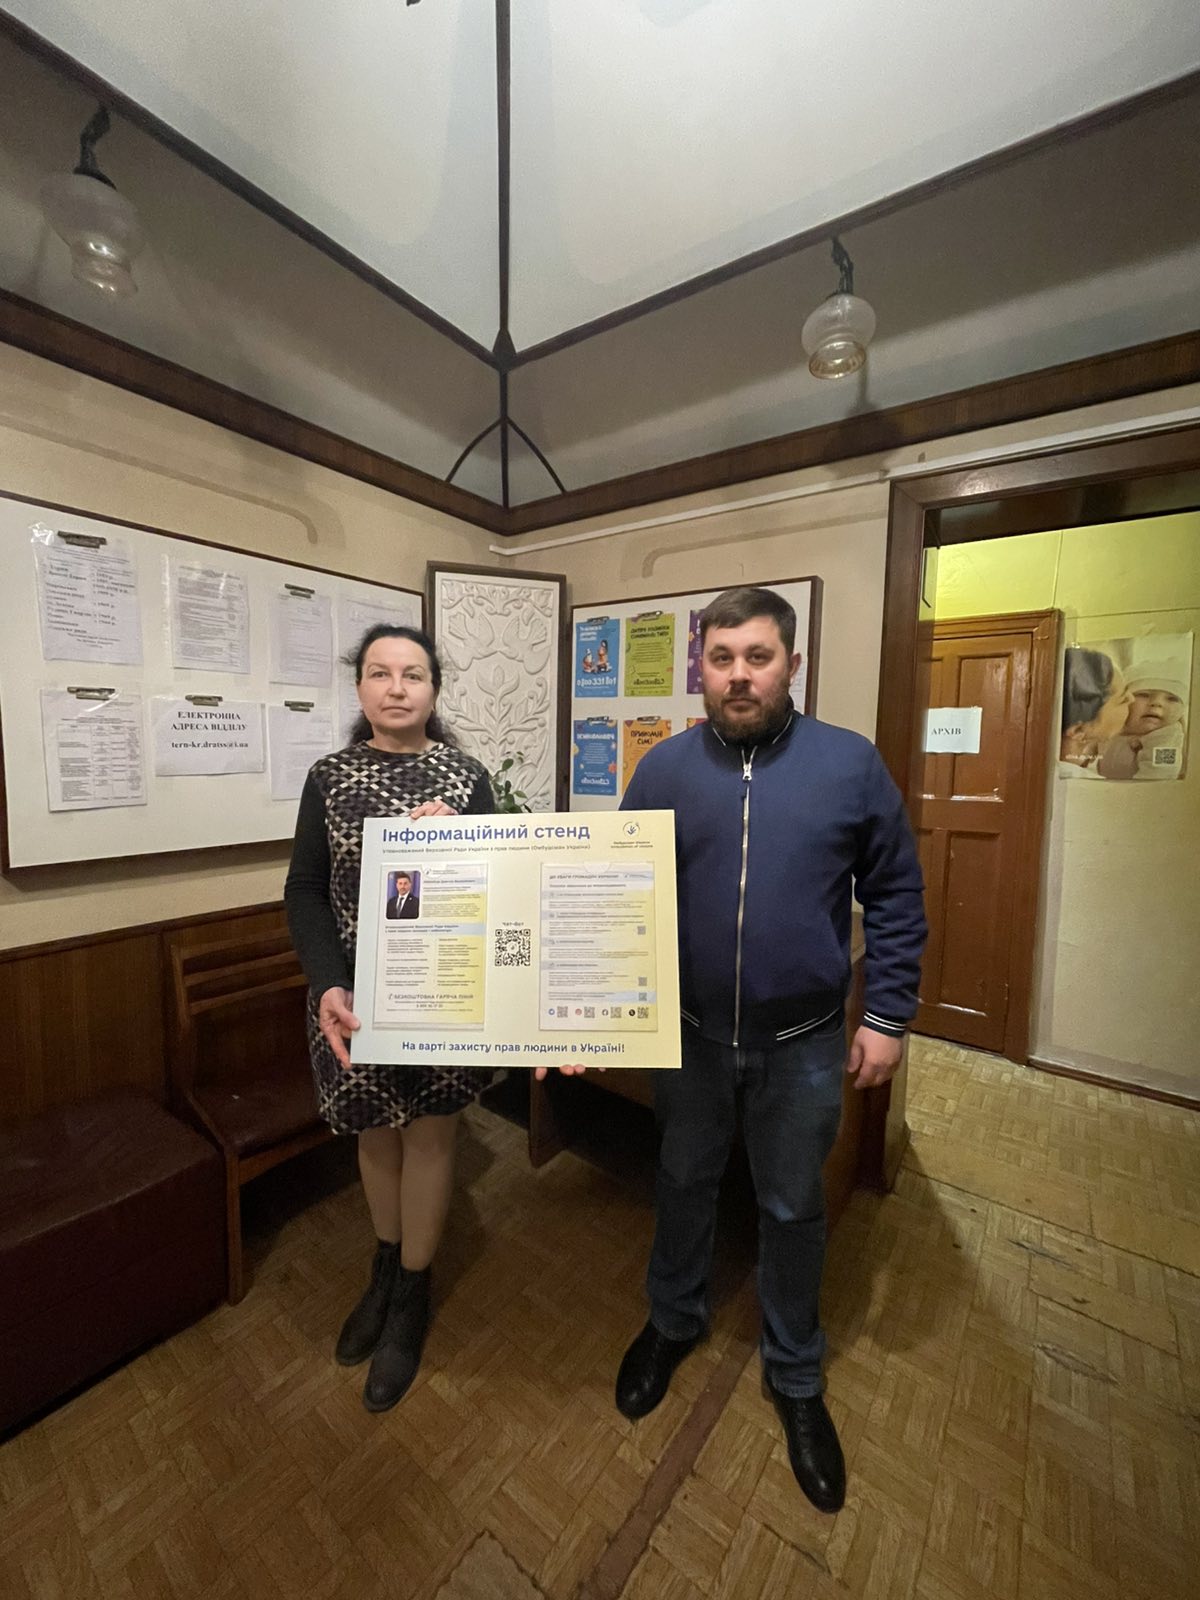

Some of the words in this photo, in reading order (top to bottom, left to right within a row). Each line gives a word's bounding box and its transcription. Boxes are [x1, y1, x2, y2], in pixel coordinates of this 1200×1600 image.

[178, 711, 241, 720] ЕЛЕКТРОННА
[171, 723, 209, 731] АДРЕСА
[383, 824, 528, 844] Інформаційний
[534, 825, 591, 840] стенд
[402, 1041, 416, 1051] На
[418, 1041, 446, 1053] варті
[448, 1042, 491, 1054] захисту
[494, 1043, 521, 1053] прав
[523, 1043, 568, 1053] людини
[580, 1043, 625, 1054] Україні!
